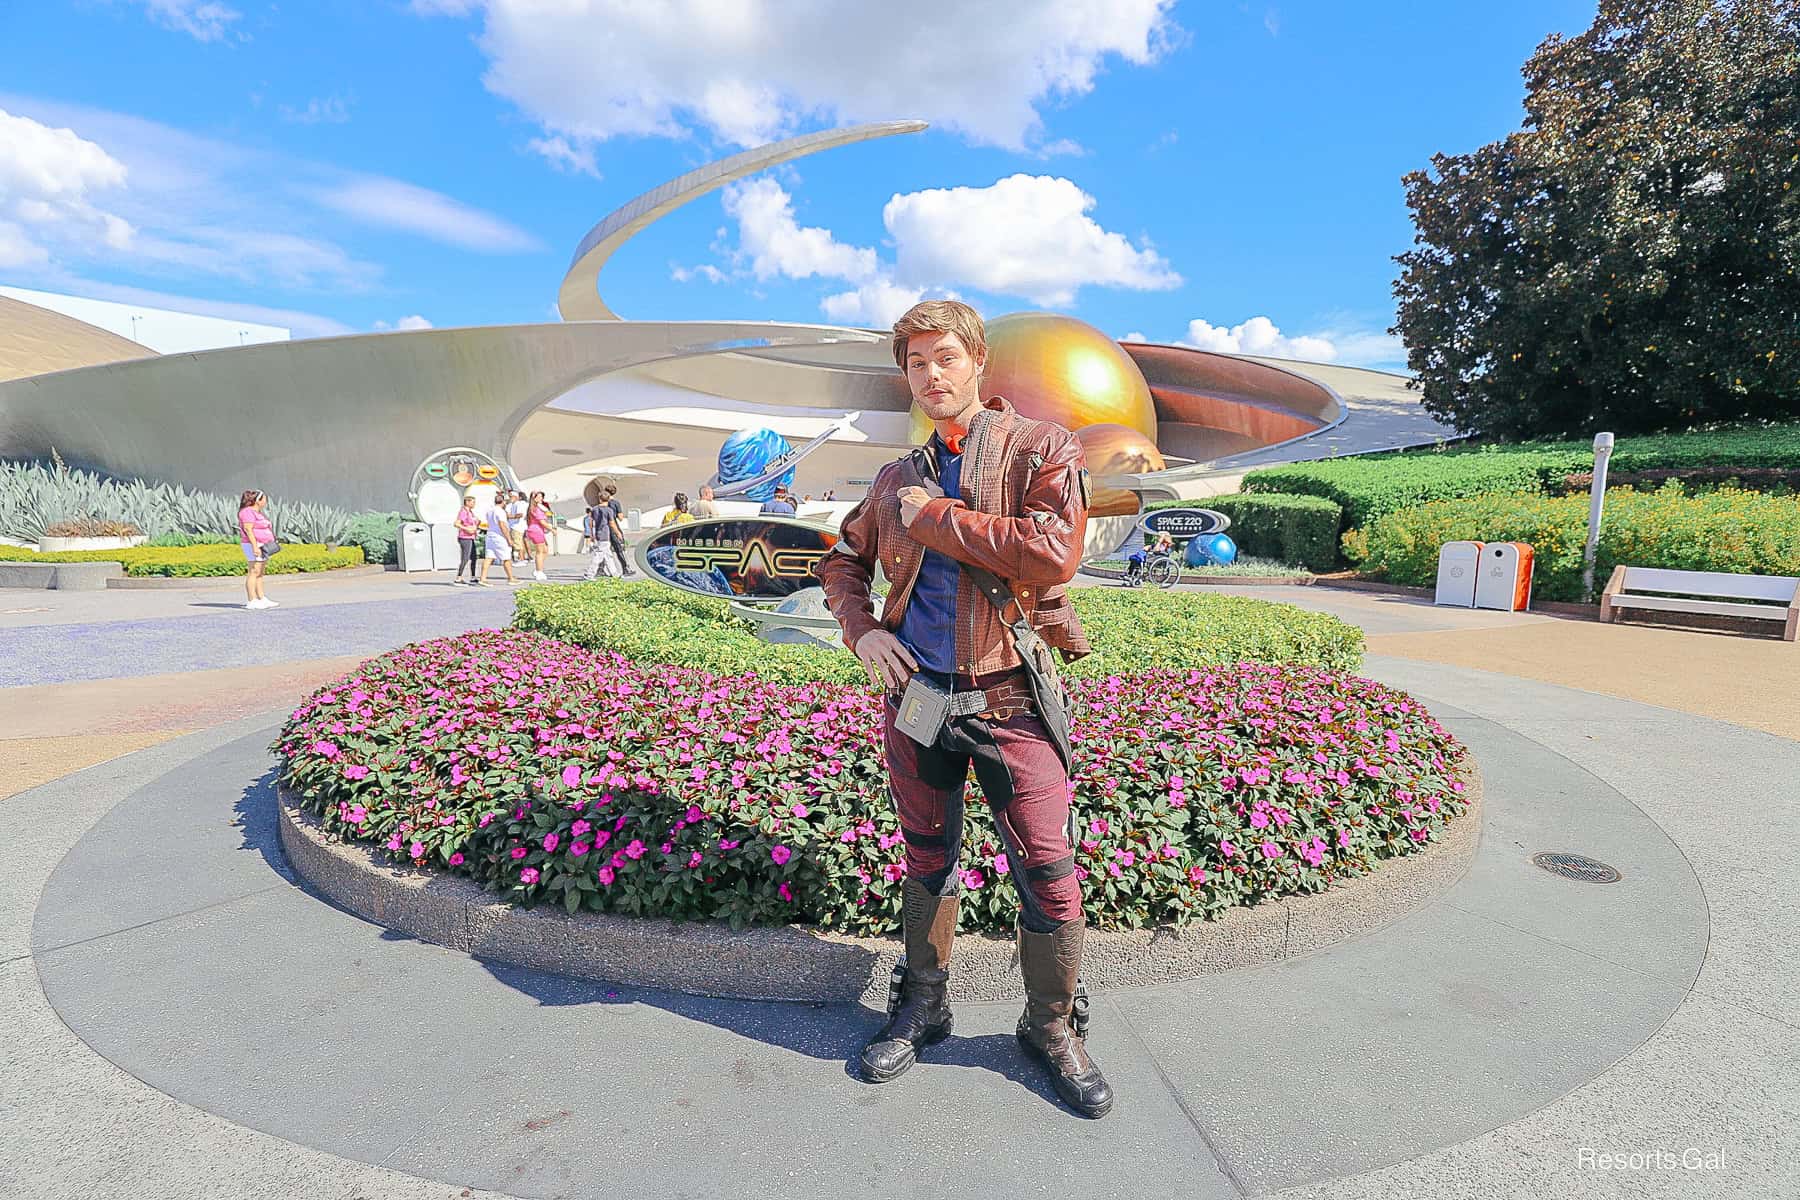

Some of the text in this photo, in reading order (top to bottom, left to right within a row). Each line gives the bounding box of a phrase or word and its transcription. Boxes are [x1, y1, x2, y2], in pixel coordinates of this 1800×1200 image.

[1157, 516, 1203, 526] SPACE 220
[676, 538, 744, 548] MISSION
